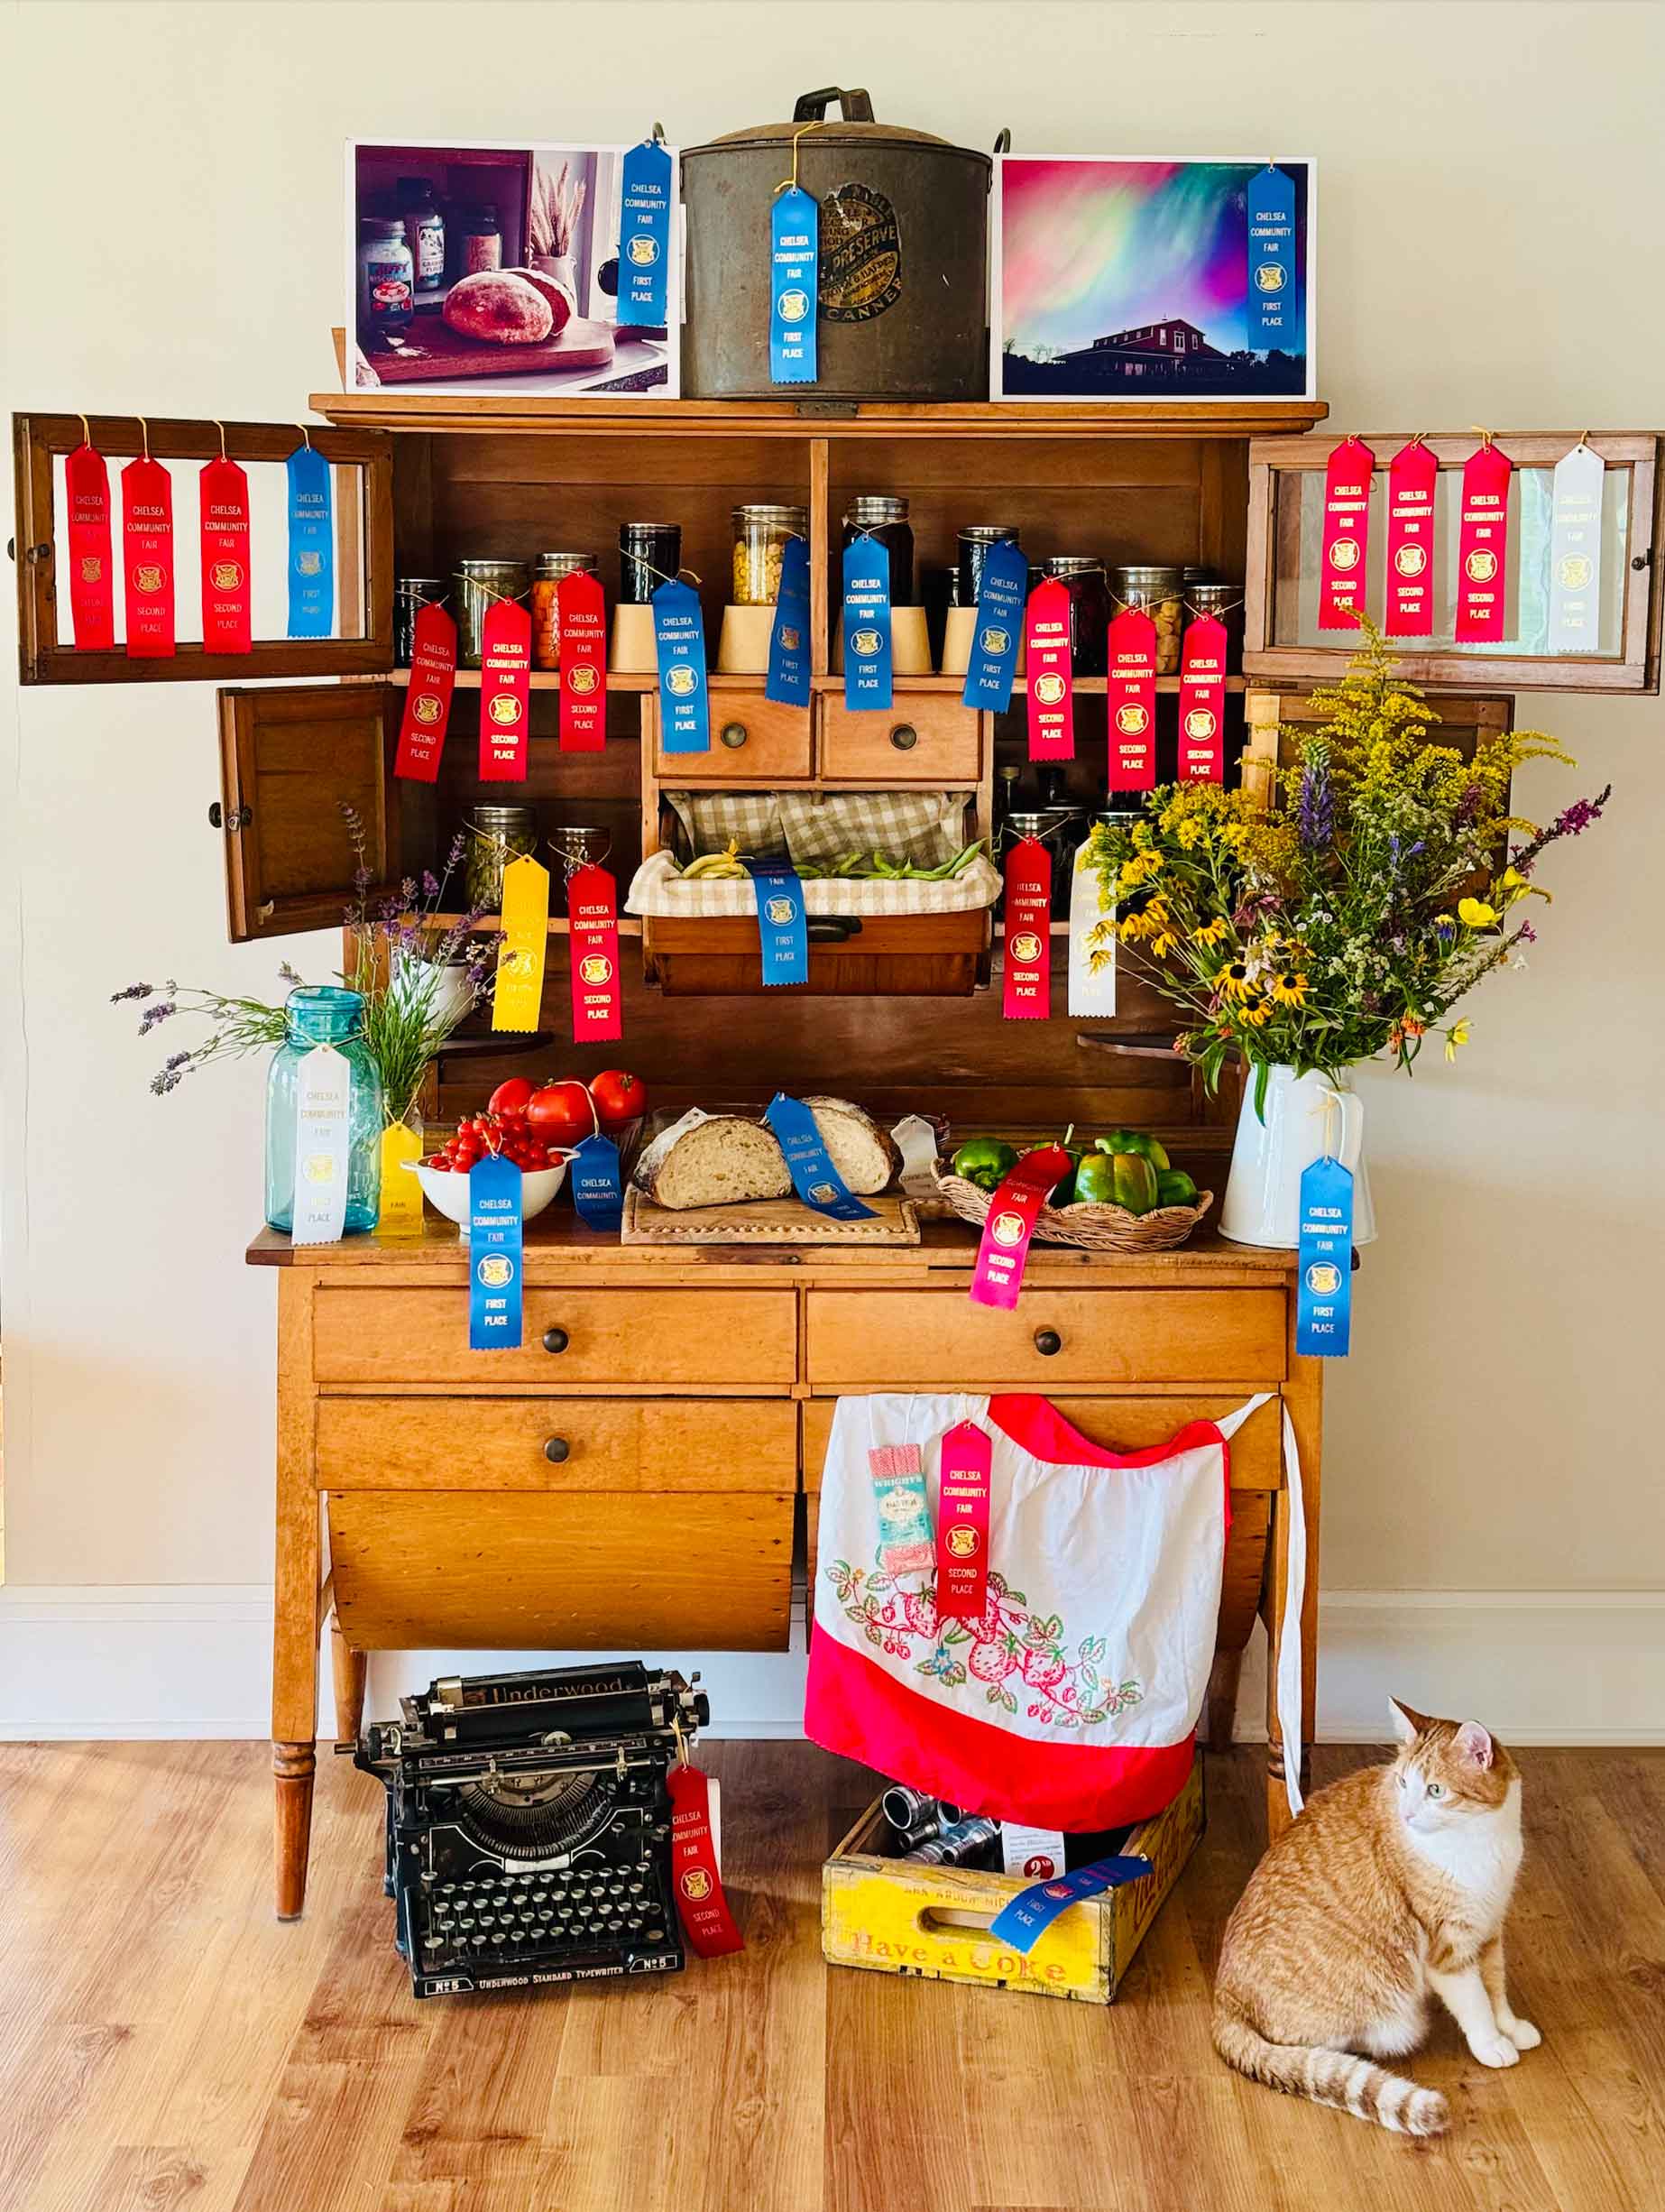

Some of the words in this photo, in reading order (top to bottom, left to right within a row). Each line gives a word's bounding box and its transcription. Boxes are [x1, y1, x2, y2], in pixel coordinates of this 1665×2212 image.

[631, 184, 661, 194] CHELSEA
[625, 198, 667, 209] COMMUNITY
[638, 216, 653, 224] FAIR
[1256, 212, 1285, 222] CHELSEA
[1251, 227, 1292, 236] COMMUNITY
[780, 235, 808, 246] CHELSEA
[832, 226, 896, 268] PRESERVE
[1264, 243, 1279, 252] FAIR
[774, 252, 814, 263] COMMUNITY
[787, 269, 801, 278] FAIR
[633, 276, 652, 286] FIRST
[631, 291, 653, 301] PLACE
[827, 277, 902, 320] CANNER
[1263, 318, 1283, 326] PLACE
[784, 332, 802, 342] FIRST
[782, 349, 803, 358] PLACE
[1335, 486, 1362, 495] CHELSEA
[297, 494, 323, 503] CHELSEA
[1399, 491, 1427, 501] CHELSEA
[1470, 495, 1499, 505] CHELSEA
[133, 506, 164, 516] CHELSEA
[211, 505, 242, 515] CHELSEA
[1329, 502, 1366, 512] COMMUNITY
[1393, 507, 1432, 517] COMMUNITY
[1465, 512, 1504, 521] COMMUNITY
[127, 523, 170, 532] COMMUNITY
[205, 521, 247, 532] COMMUNITY
[1339, 518, 1354, 527] FAIR
[1404, 523, 1420, 532] FAIR
[1476, 529, 1491, 538] FAIR
[219, 539, 235, 548] FAIR
[851, 579, 880, 588] CHELSEA
[990, 576, 1017, 590] CHELSEA
[1331, 581, 1357, 590] SECOND
[1397, 587, 1423, 596] SECOND
[846, 594, 887, 604] COMMUNITY
[983, 590, 1022, 605] COMMUNITY
[1333, 597, 1353, 606] PLACE
[1467, 594, 1495, 603] SECOND
[137, 606, 165, 616] SECOND
[214, 604, 242, 613] SECOND
[992, 606, 1007, 617] FAIR
[1400, 603, 1421, 613] PLACE
[570, 613, 598, 623] CHELSEA
[860, 610, 875, 619] FAIR
[1470, 610, 1490, 619] PLACE
[217, 620, 238, 629] PLACE
[663, 617, 693, 626] CHELSEA
[1035, 622, 1063, 632] CHELSEA
[564, 629, 604, 639] COMMUNITY
[658, 631, 699, 641] COMMUNITY
[492, 643, 523, 653] CHELSEA
[1030, 638, 1068, 648] COMMUNITY
[423, 642, 449, 655] CHELSEA
[577, 644, 592, 653] FAIR
[673, 646, 688, 655] FAIR
[1043, 653, 1057, 663] FAIR
[1118, 654, 1147, 663] CHELSEA
[416, 657, 454, 672] COMMUNITY
[486, 659, 528, 669] COMMUNITY
[782, 659, 799, 669] FIRST
[1190, 659, 1218, 668] CHELSEA
[859, 665, 878, 674] FIRST
[983, 664, 1001, 674] FIRST
[1112, 669, 1154, 678] COMMUNITY
[426, 675, 440, 685] FAIR
[500, 675, 514, 684] FAIR
[780, 674, 799, 685] PLACE
[858, 679, 878, 688] PLACE
[980, 678, 1000, 690] PLACE
[1183, 674, 1222, 684] COMMUNITY
[1126, 685, 1140, 693] FAIR
[1195, 690, 1210, 698] FAIR
[571, 705, 597, 714] SECOND
[676, 705, 694, 714] FIRST
[1038, 714, 1064, 724] SECOND
[575, 721, 593, 729] PLACE
[675, 721, 696, 731] PLACE
[411, 733, 436, 744] SECOND
[1042, 729, 1062, 738] PLACE
[491, 735, 519, 744] SECOND
[411, 749, 429, 759] PLACE
[1118, 745, 1146, 754] SECOND
[494, 750, 515, 760] PLACE
[1187, 750, 1213, 760] SECOND
[1122, 760, 1144, 769] PLACE
[1191, 765, 1210, 775] PLACE
[579, 906, 609, 915] CHELSEA
[1019, 912, 1035, 922] FAIR
[575, 919, 614, 930] COMMUNITY
[588, 935, 603, 945] FAIR
[776, 936, 794, 945] FIRST
[776, 953, 794, 962] PLACE
[1013, 972, 1039, 982] SECOND
[1016, 987, 1037, 996] PLACE
[584, 995, 611, 1004] SECOND
[588, 1010, 609, 1018] PLACE
[582, 1179, 612, 1187] CHELSEA
[1011, 1193, 1027, 1203] FAIR
[480, 1200, 511, 1209] CHELSEA
[308, 1213, 330, 1221] PLACE
[1309, 1208, 1341, 1218] CHELSEA
[474, 1216, 518, 1226] COMMUNITY
[1302, 1223, 1348, 1234] COMMUNITY
[488, 1232, 504, 1241] FAIR
[1317, 1241, 1333, 1250] FAIR
[989, 1254, 1016, 1269] SECOND
[987, 1270, 1010, 1285] PLACE
[486, 1299, 506, 1308] FIRST
[1313, 1307, 1333, 1317] FIRST
[484, 1315, 508, 1325] PLACE
[1311, 1323, 1335, 1332] PLACE
[950, 1470, 981, 1480] CHELSEA
[943, 1487, 987, 1498] COMMUNITY
[956, 1505, 972, 1514] FAIR
[949, 1568, 977, 1578] SECOND
[952, 1585, 972, 1594] PLACE
[673, 1811, 701, 1824] CHELSEA
[672, 1826, 707, 1841] OMMUNITY
[684, 1846, 698, 1857] FAIR
[693, 1909, 720, 1922] SECOND
[1014, 1909, 1035, 1927] PLACE
[702, 1924, 723, 1935] PLACE
[851, 1932, 927, 1961] Have
[943, 1953, 956, 1966] a
[970, 1949, 1066, 1981] Coke
[659, 1959, 667, 1968] 5
